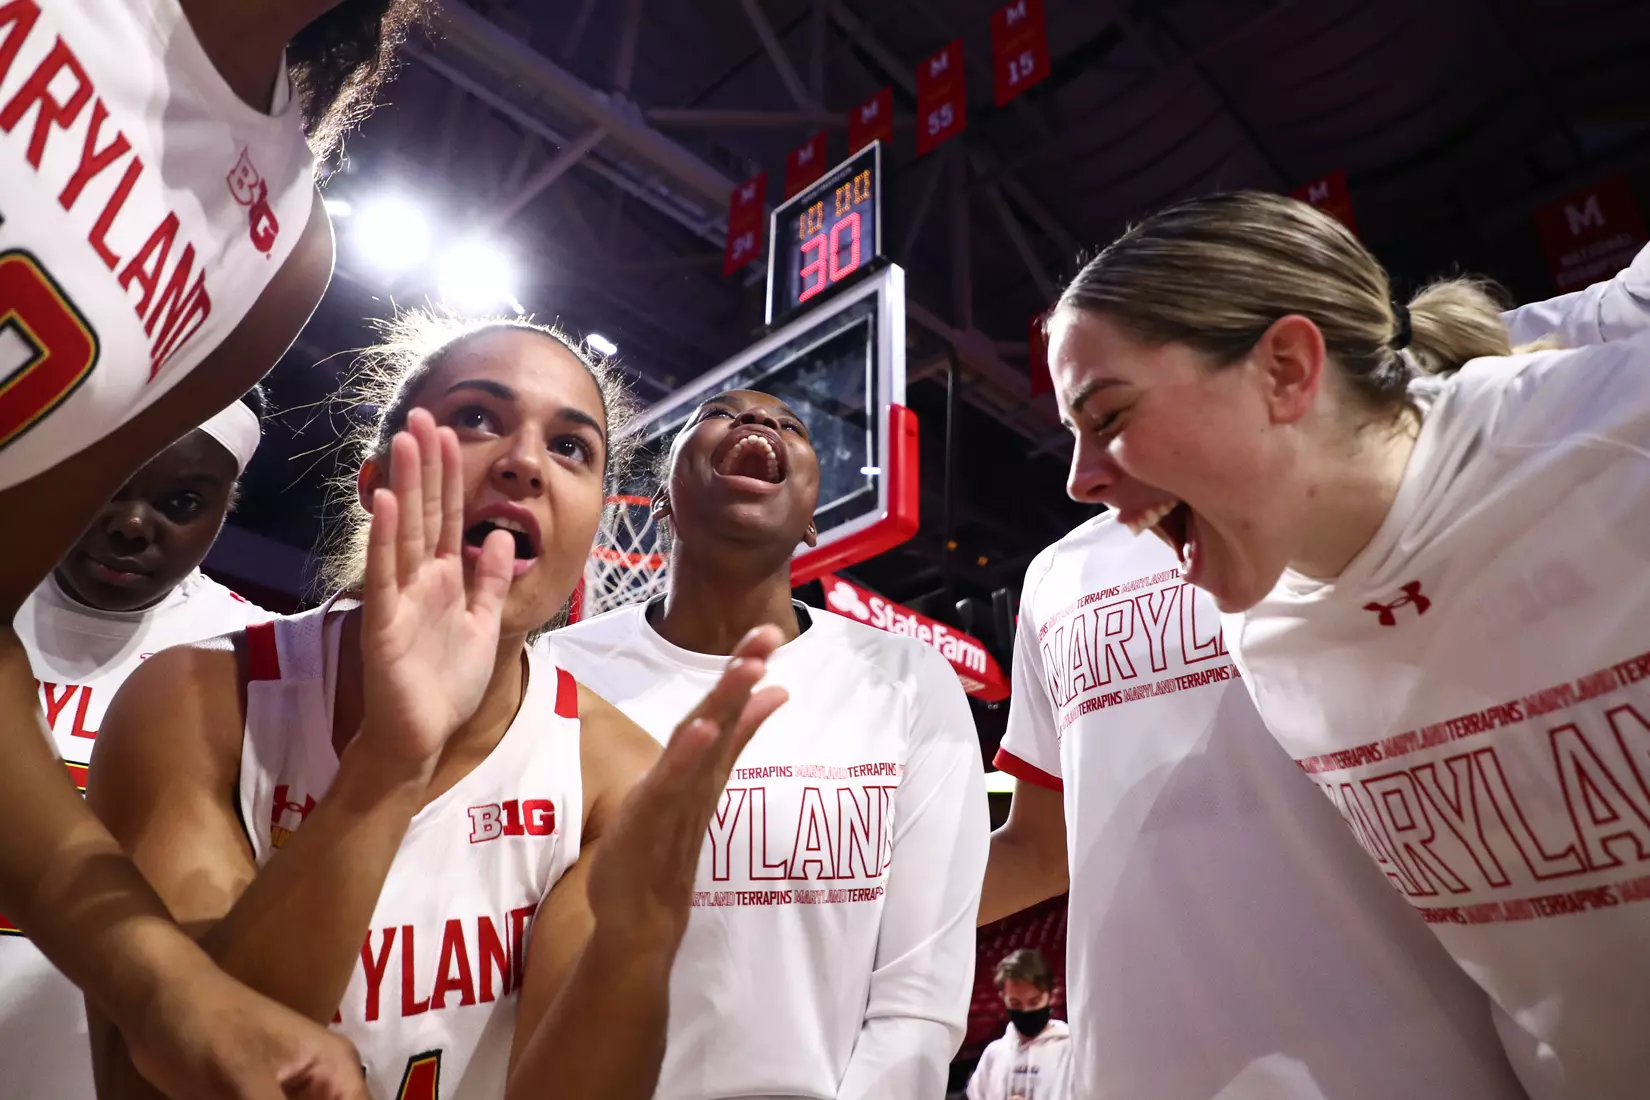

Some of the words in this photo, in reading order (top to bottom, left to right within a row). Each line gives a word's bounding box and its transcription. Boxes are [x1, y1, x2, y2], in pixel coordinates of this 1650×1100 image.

[1008, 50, 1034, 86] 15
[927, 101, 953, 136] 55
[1563, 195, 1606, 235] M
[799, 212, 861, 302] 30
[1077, 585, 1120, 609] TERRAPINS
[1078, 691, 1123, 716] TERRAPINS
[1175, 666, 1230, 691] TERRAPINS
[1445, 700, 1524, 740] TERRAPINS
[736, 765, 793, 780] TERRAPINS
[736, 889, 793, 907] TERRAPINS
